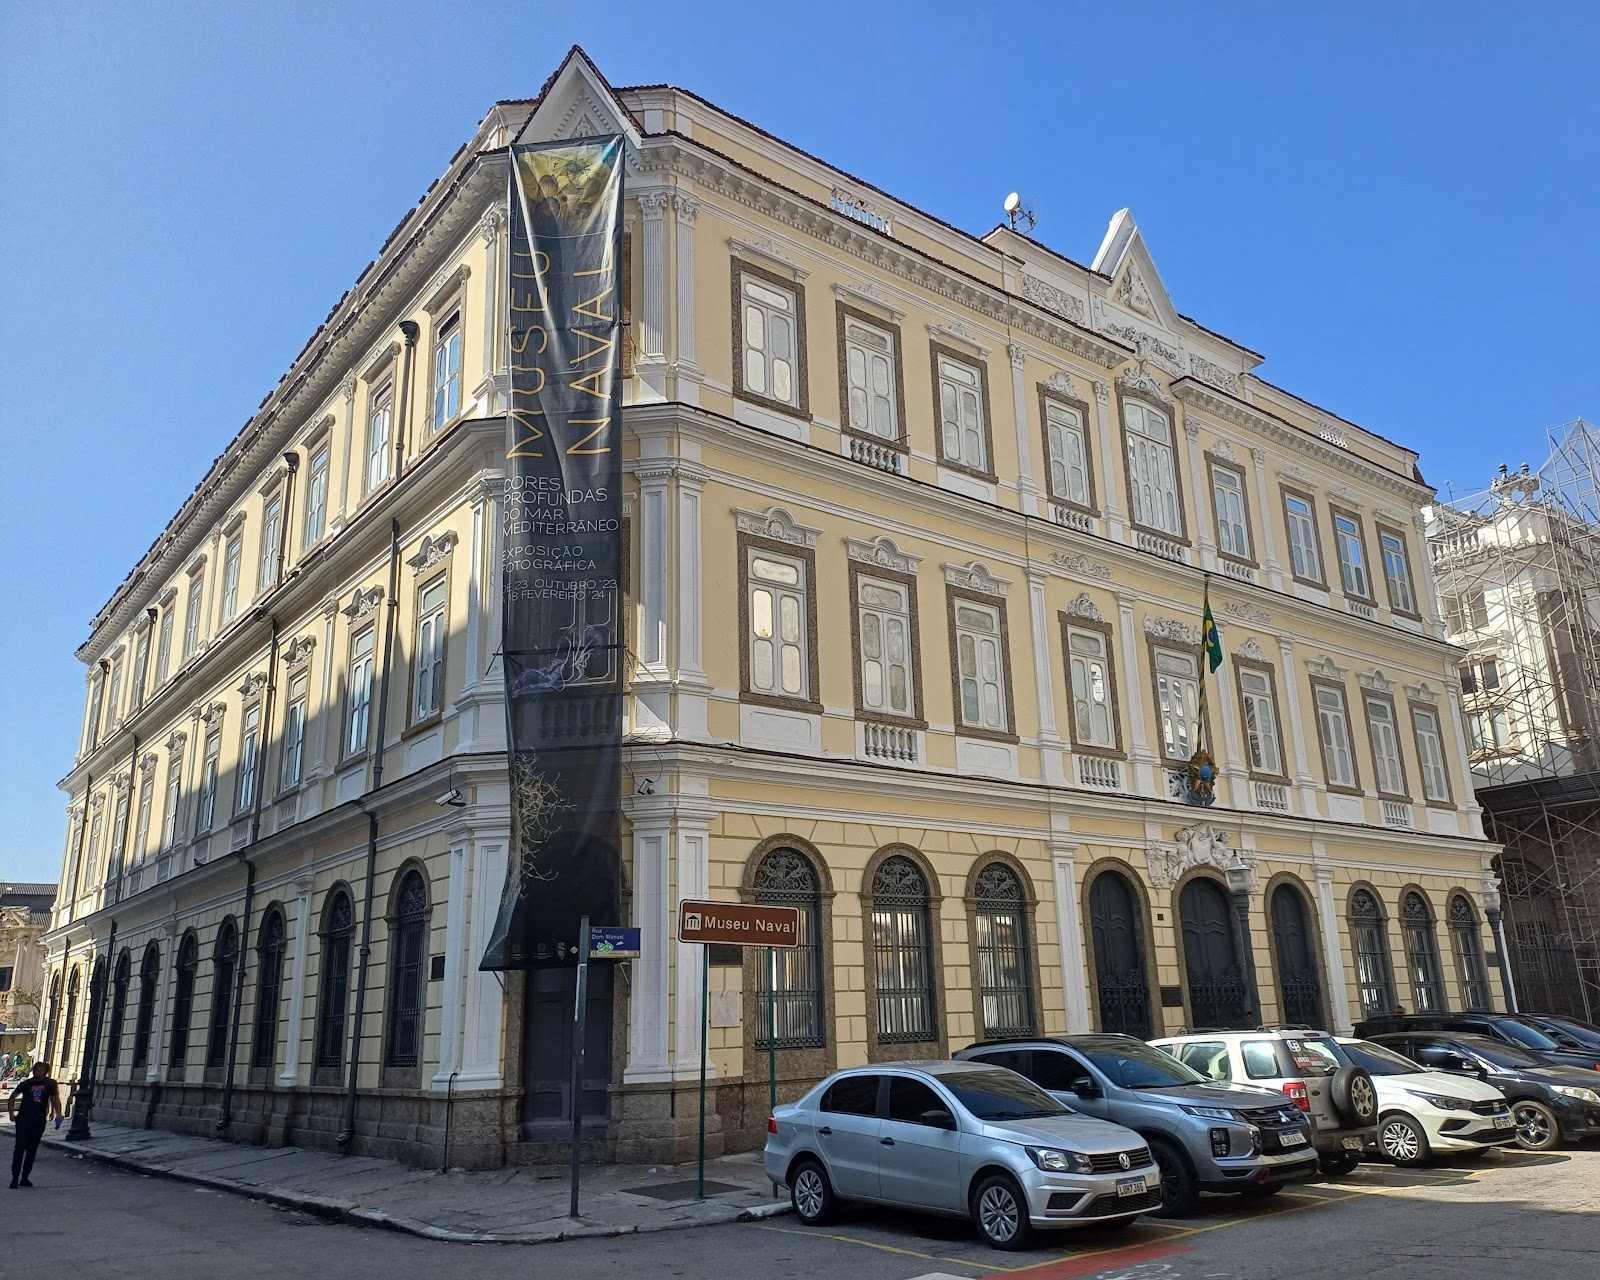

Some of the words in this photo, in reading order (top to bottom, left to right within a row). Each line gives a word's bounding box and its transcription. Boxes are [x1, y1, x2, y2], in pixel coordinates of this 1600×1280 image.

[506, 250, 550, 460] MUSEU
[566, 243, 614, 455] NAVAL
[503, 476, 560, 493] CORES
[503, 488, 608, 509] PROFUNDAS
[503, 507, 520, 523] DO
[524, 506, 563, 520] MAR
[503, 519, 619, 538] MEDITERRÂNEO
[502, 544, 583, 561] EXPOSIÇÃO
[514, 579, 528, 590] 23
[534, 578, 597, 591] OUTUBRO
[521, 588, 585, 601] FEVEREIRO
[704, 915, 750, 931] Museu
[755, 918, 795, 934] Naval
